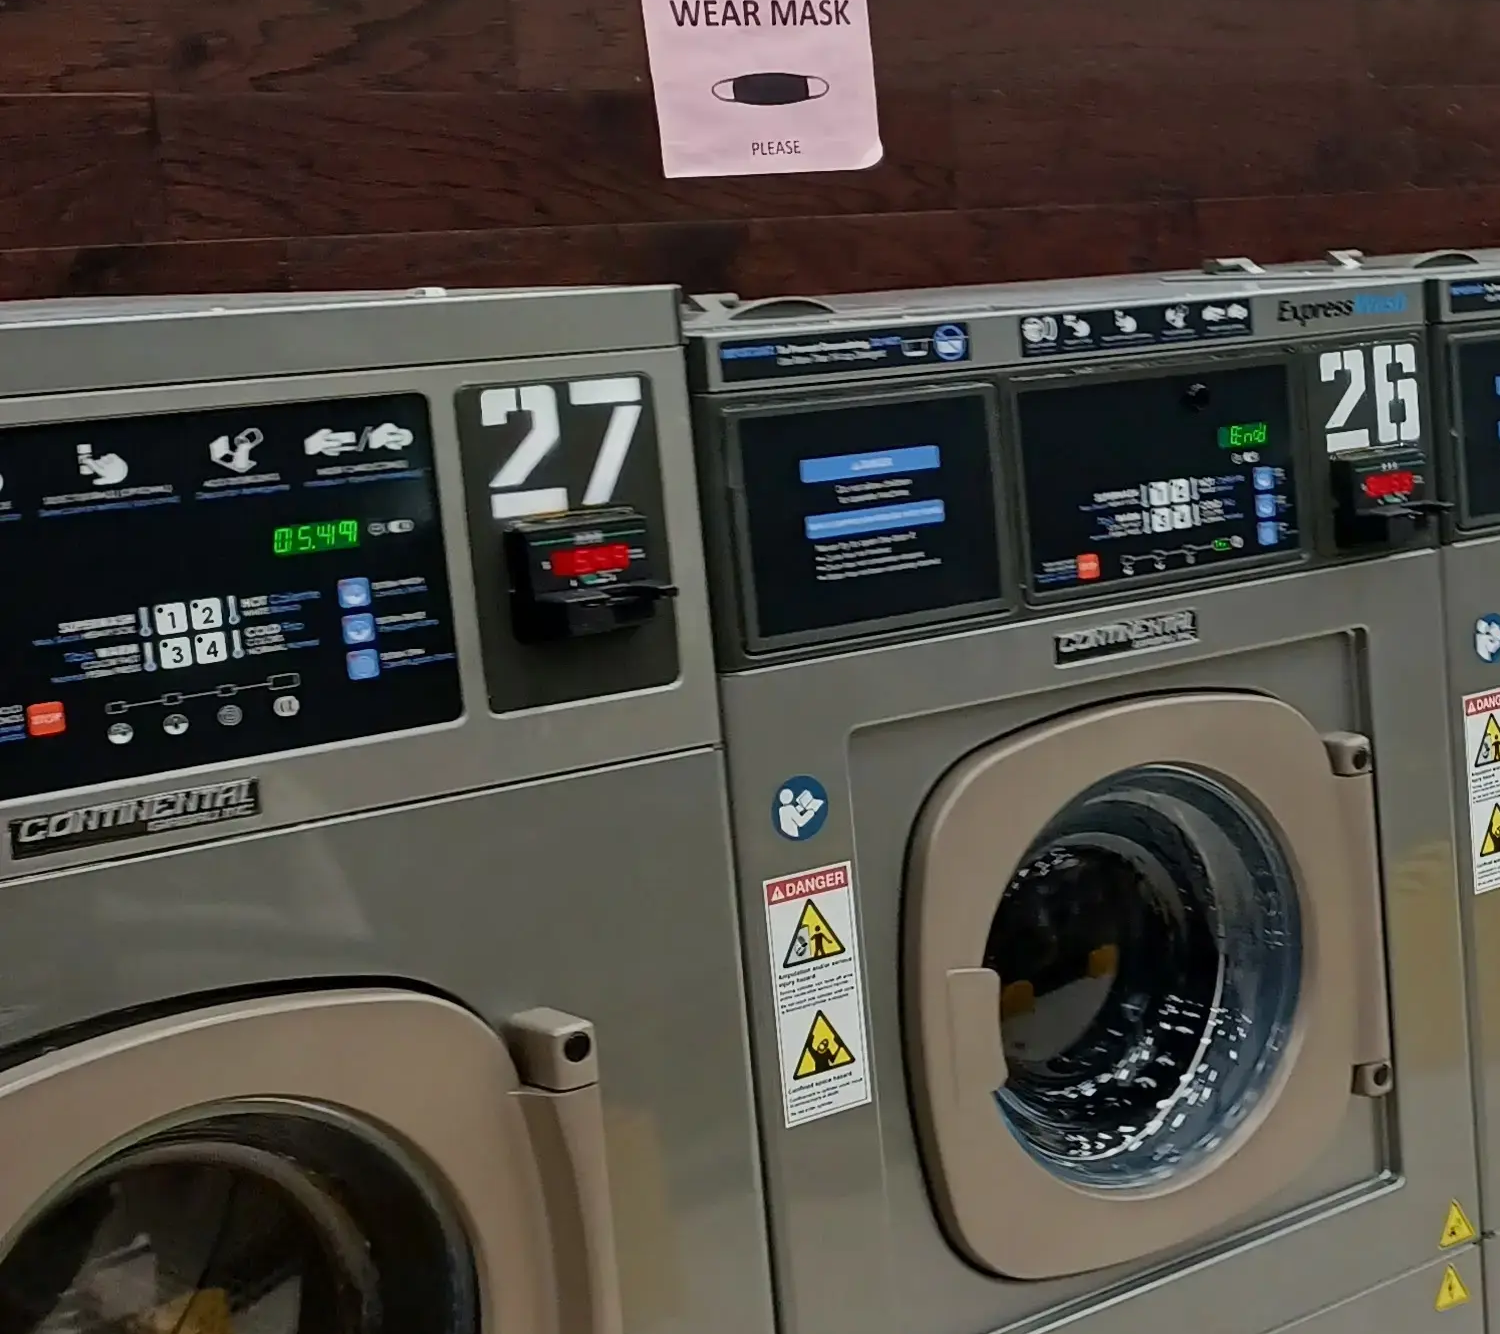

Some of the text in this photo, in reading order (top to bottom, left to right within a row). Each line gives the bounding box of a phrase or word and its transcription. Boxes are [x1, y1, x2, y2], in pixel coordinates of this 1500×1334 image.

[670, 0, 851, 28] WEAR MASK
[751, 139, 801, 157] PLEASE
[1319, 343, 1420, 453] 26
[480, 376, 642, 519] 27
[1230, 422, 1267, 447] End
[202, 606, 215, 625] 2
[172, 646, 184, 664] 3
[206, 641, 219, 658] 4
[19, 779, 255, 844] CONTINENTAL
[785, 870, 845, 897] DANGER
